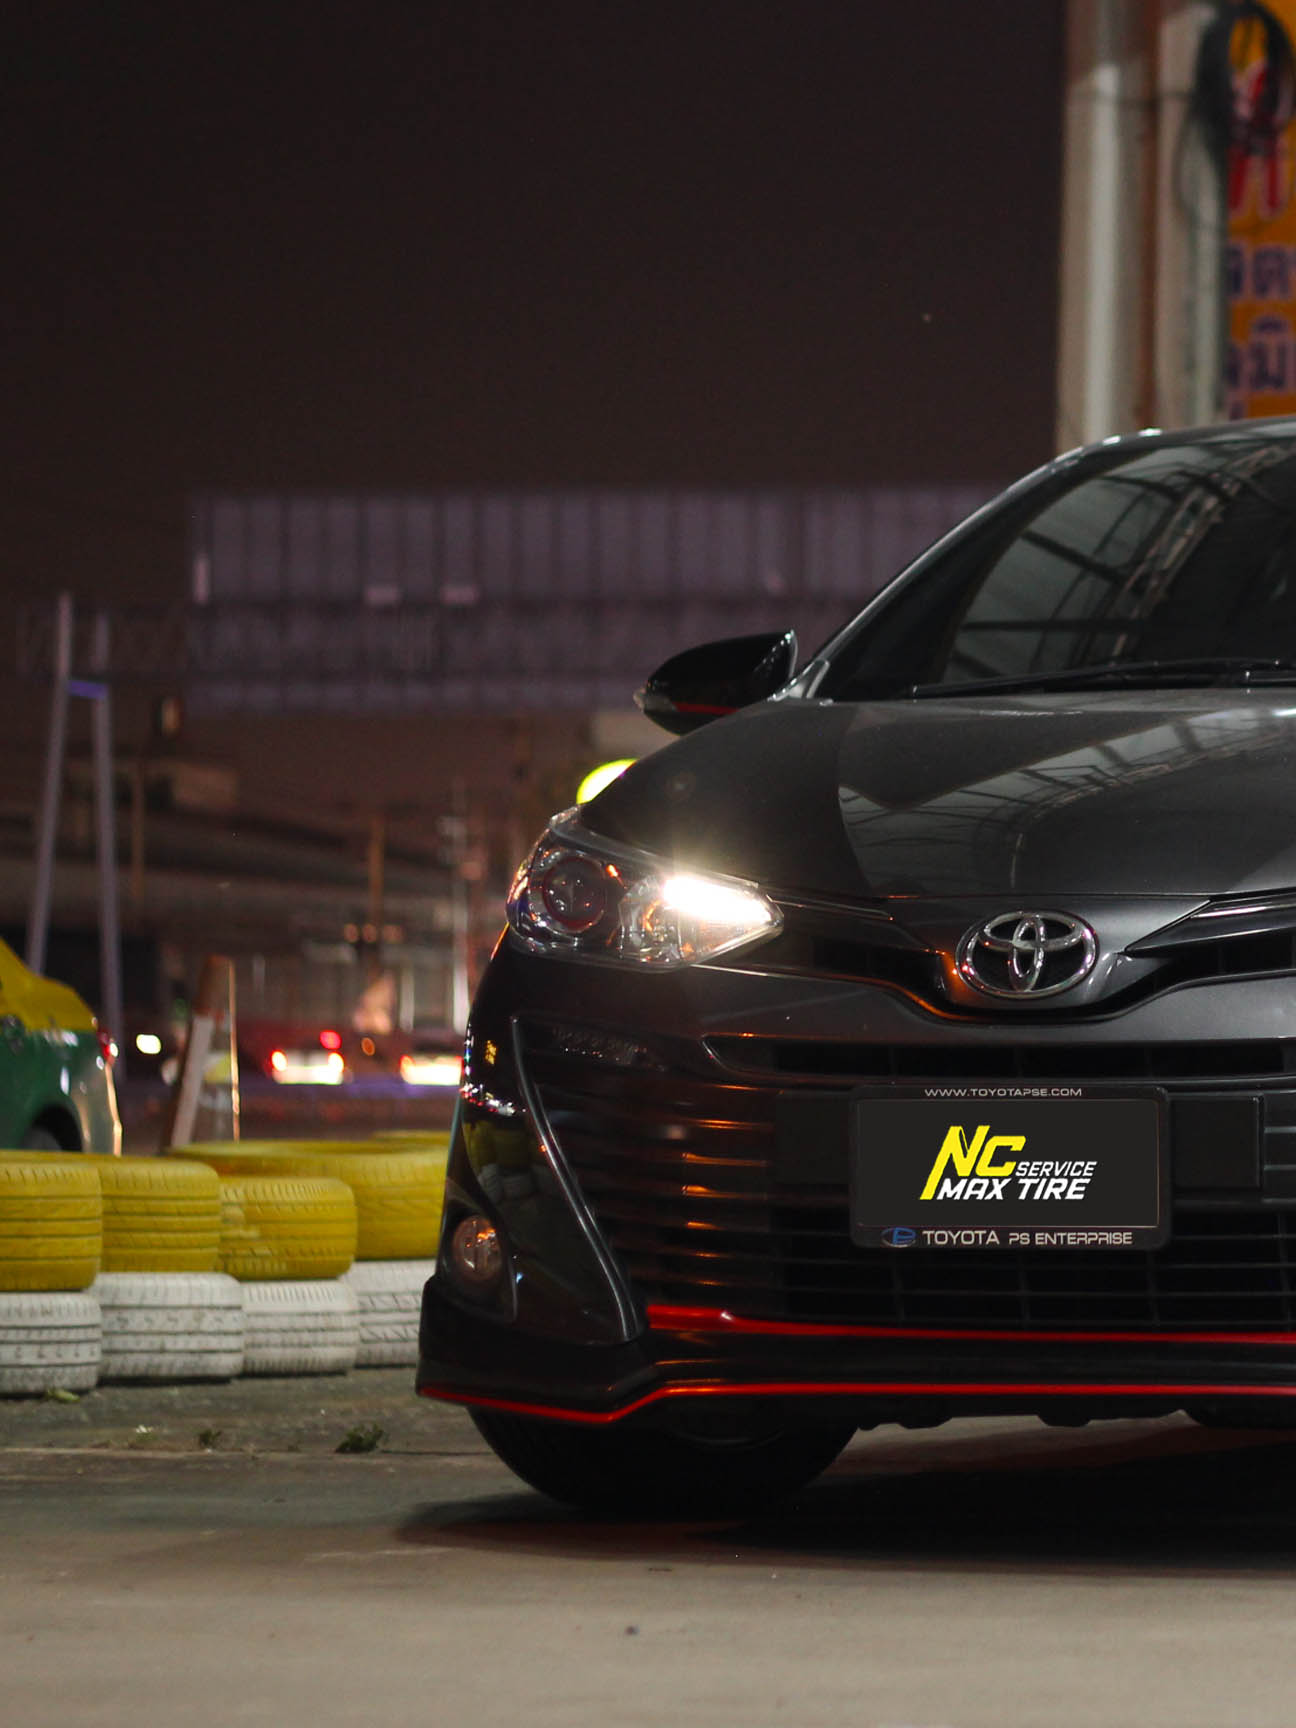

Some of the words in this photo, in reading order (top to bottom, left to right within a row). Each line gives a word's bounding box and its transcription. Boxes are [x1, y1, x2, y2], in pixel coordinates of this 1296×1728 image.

[924, 1088, 1082, 1097] WWW.TOYOTAPSE.COM
[922, 1230, 1000, 1246] TOYOTA
[1008, 1232, 1031, 1245] PS
[1034, 1231, 1133, 1246] ENTERPRISE
